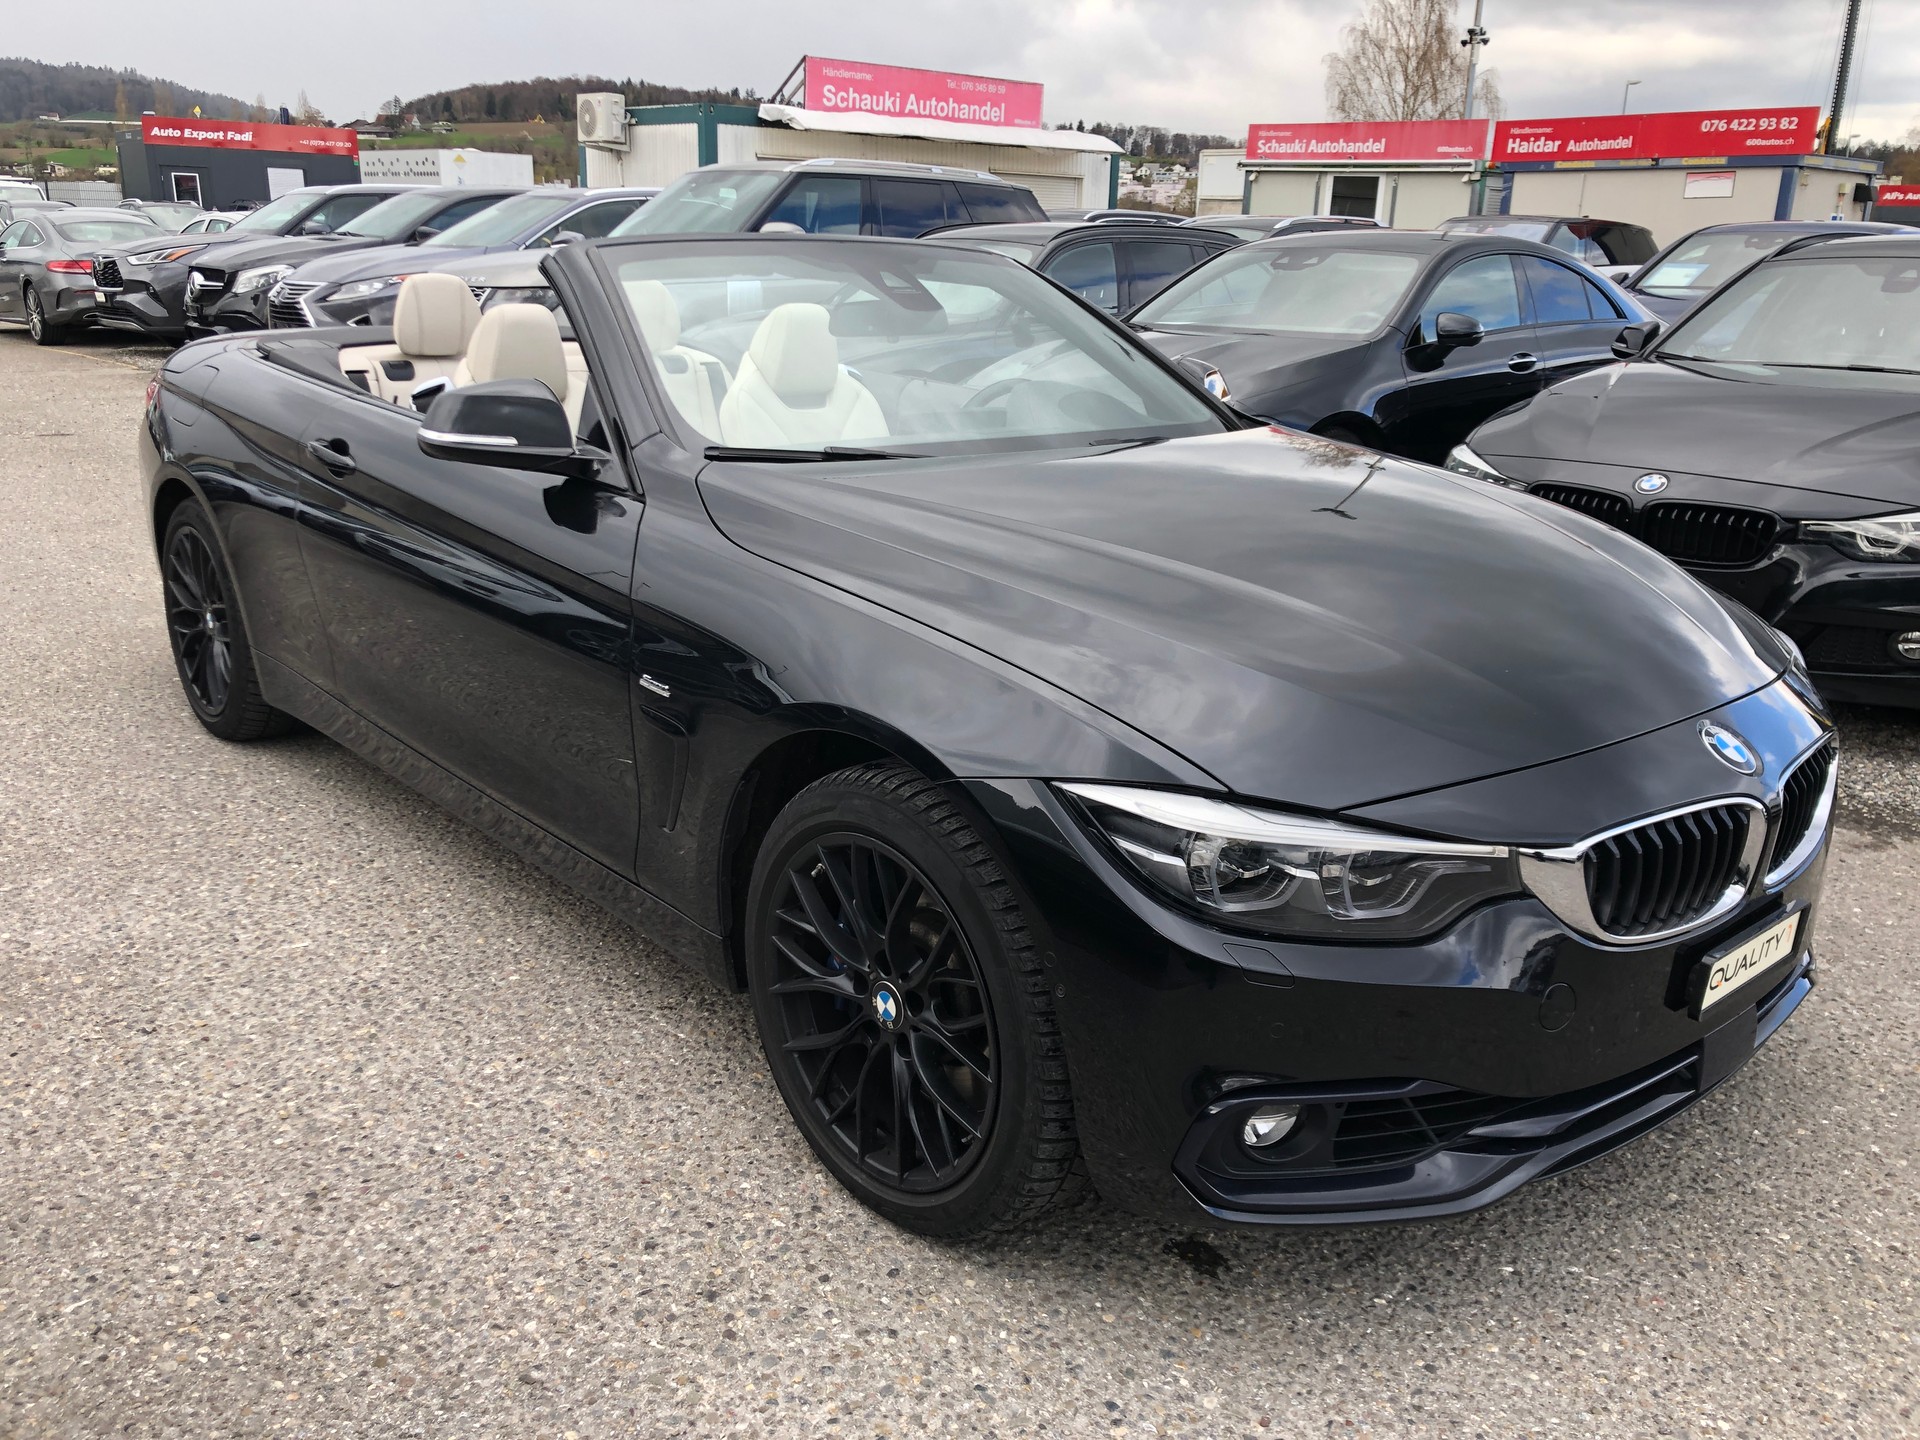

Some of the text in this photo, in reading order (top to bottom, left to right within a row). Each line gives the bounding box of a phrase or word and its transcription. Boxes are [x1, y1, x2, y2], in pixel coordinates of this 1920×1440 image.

[823, 84, 1005, 123] Schauki Autohandel
[1701, 117, 1799, 132] 076 422 93 82
[150, 126, 253, 142] Auto Export Fadi
[1745, 137, 1795, 146] 600autos.ch
[1257, 138, 1386, 153] Schauki Autohandel
[1507, 135, 1634, 154] Haidar Autohandel
